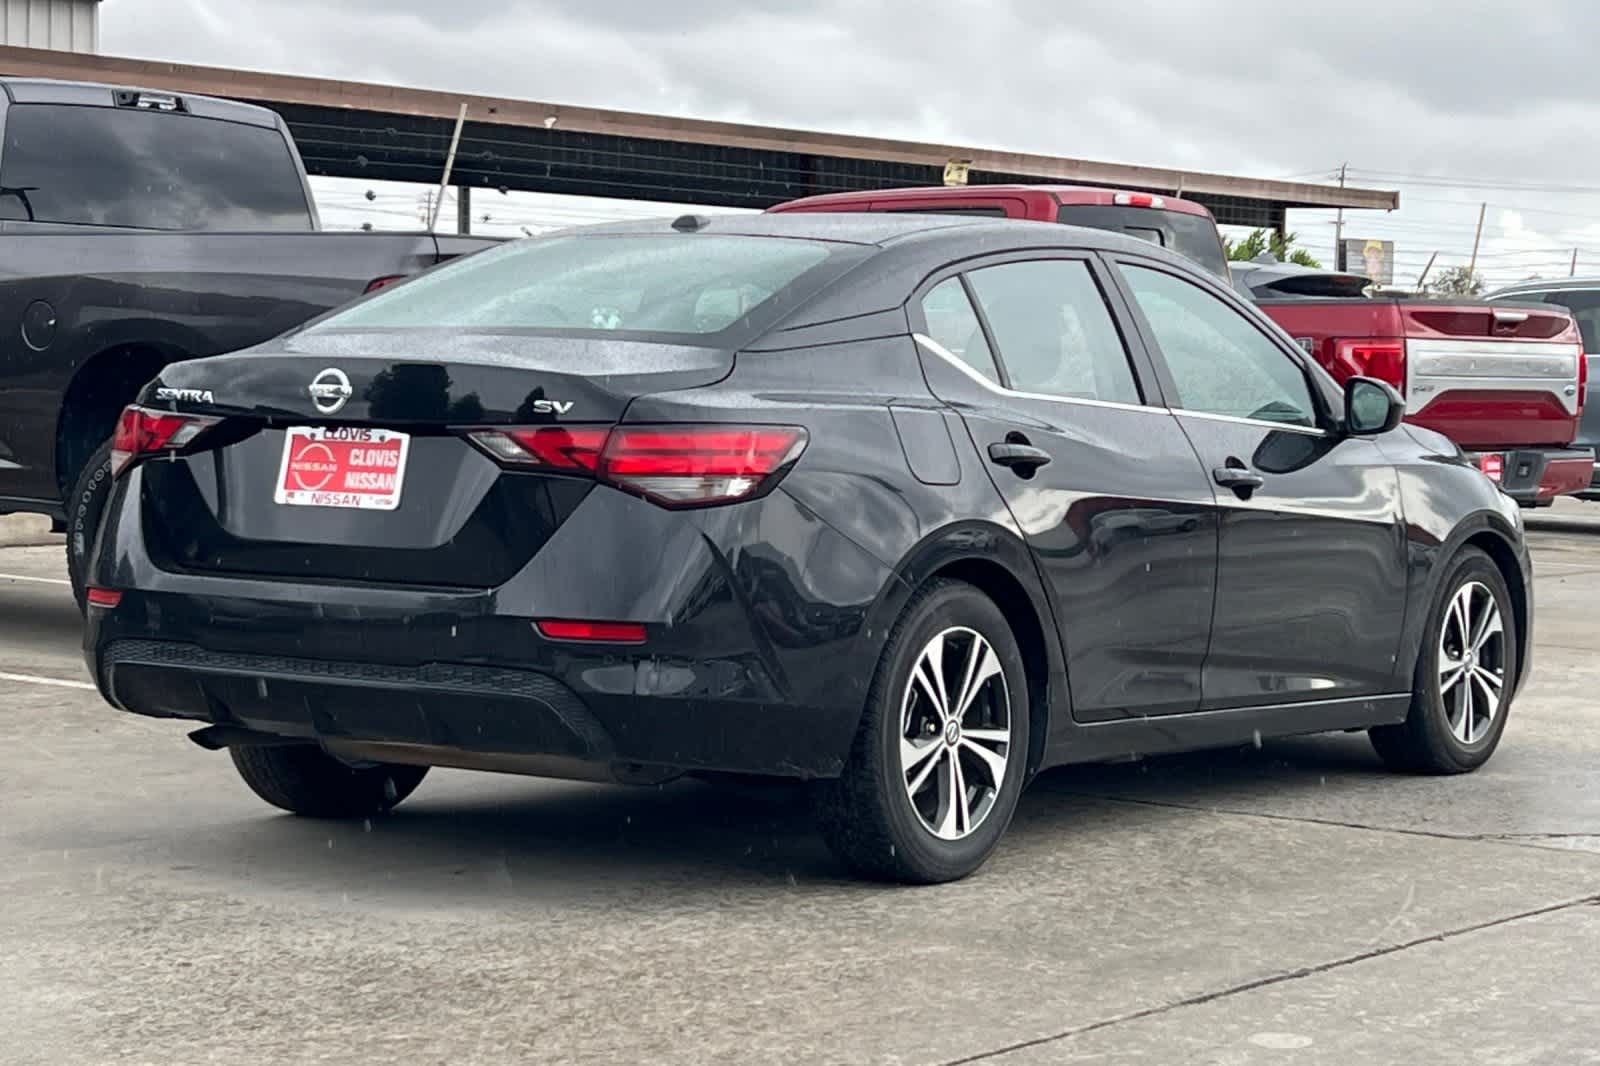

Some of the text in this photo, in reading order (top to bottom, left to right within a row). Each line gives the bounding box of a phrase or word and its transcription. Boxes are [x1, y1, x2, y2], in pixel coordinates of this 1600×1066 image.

[533, 400, 575, 414] SV
[349, 448, 399, 467] CLOVIS
[290, 461, 337, 472] NISSAN
[344, 471, 396, 490] NISSAN
[311, 493, 361, 506] NISSAN
